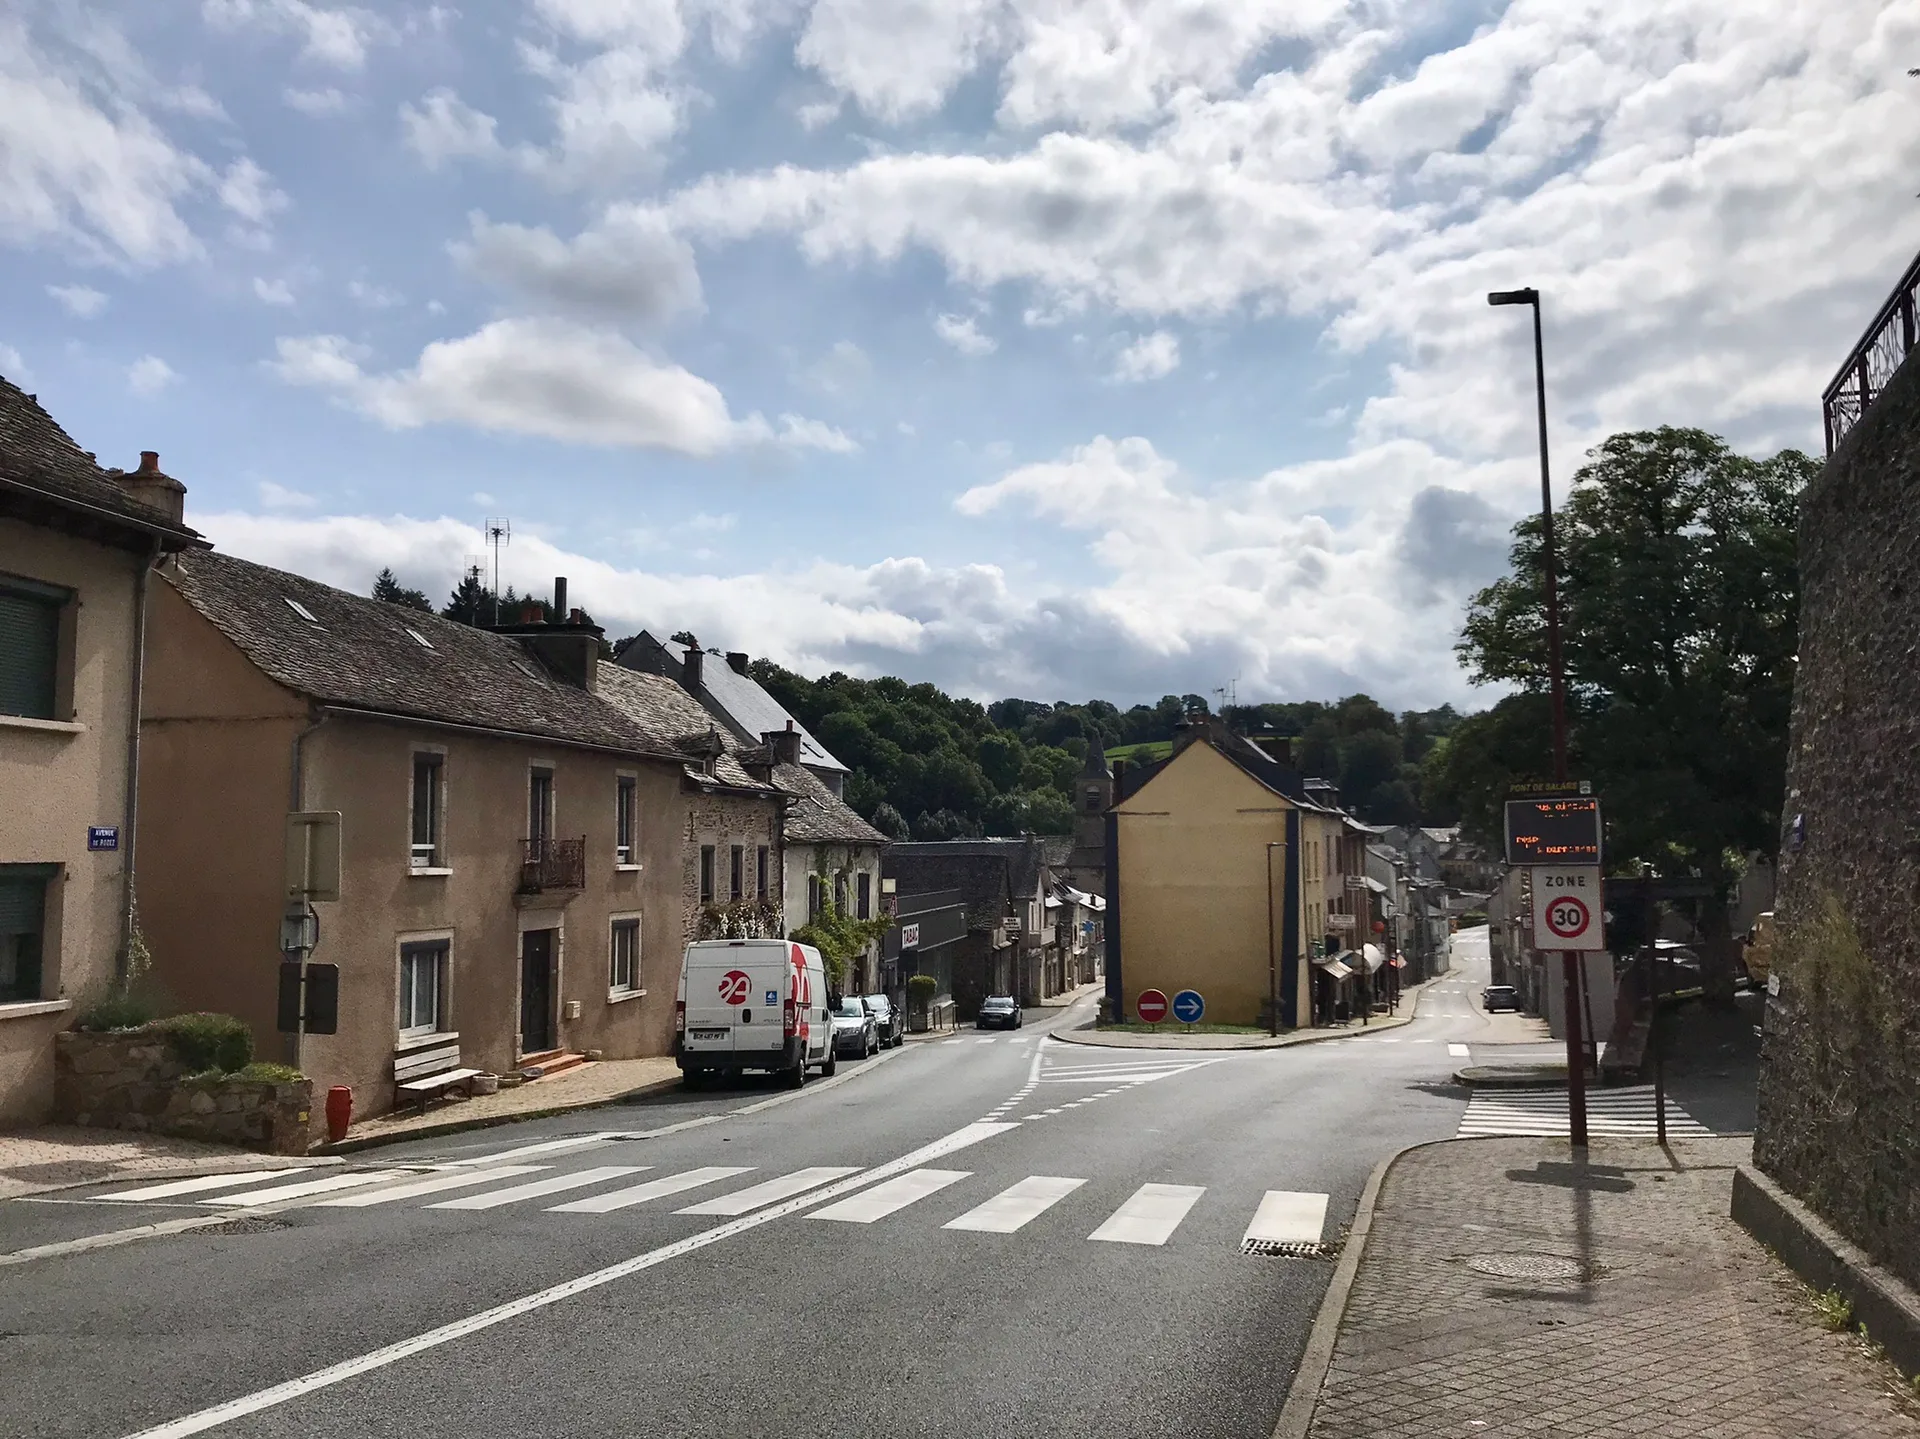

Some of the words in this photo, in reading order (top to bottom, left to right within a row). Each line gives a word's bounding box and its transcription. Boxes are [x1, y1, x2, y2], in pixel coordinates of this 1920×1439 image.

[95, 829, 114, 837] AVENUE
[1545, 875, 1586, 887] ZONE
[1554, 908, 1581, 926] 30
[904, 927, 918, 945] TABAC
